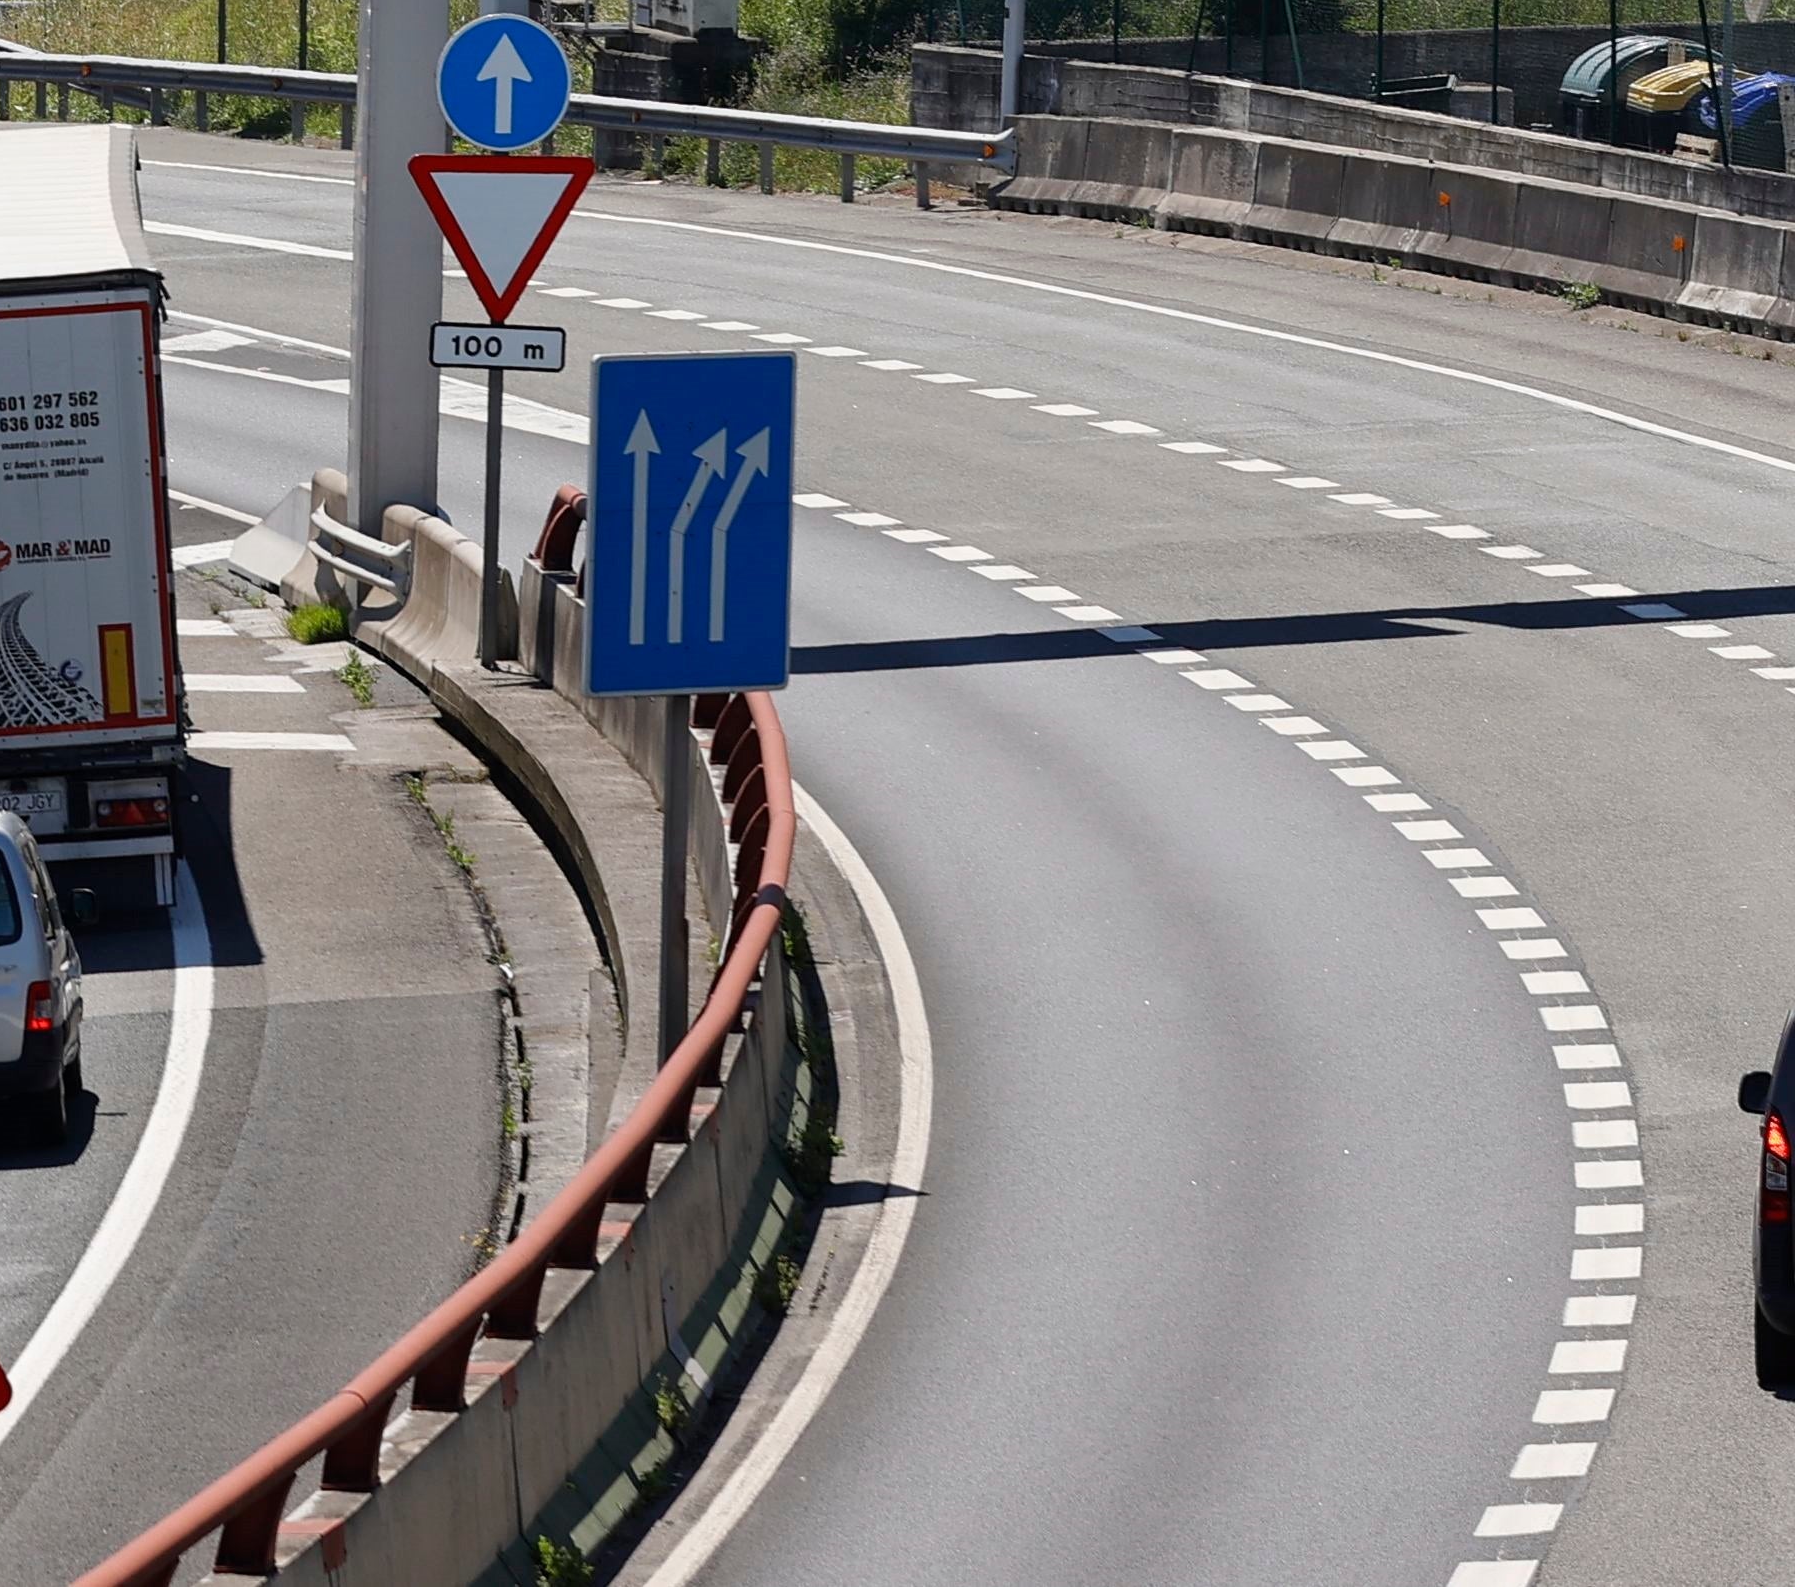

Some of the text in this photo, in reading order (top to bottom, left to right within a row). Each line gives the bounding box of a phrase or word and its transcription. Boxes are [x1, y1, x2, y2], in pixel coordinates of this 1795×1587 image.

[452, 334, 545, 360] 100 m
[33, 393, 62, 409] 297
[69, 391, 98, 406] 562
[0, 412, 99, 432] 636 032 805
[16, 538, 111, 558] MAR & MAD
[28, 795, 54, 809] JGY
